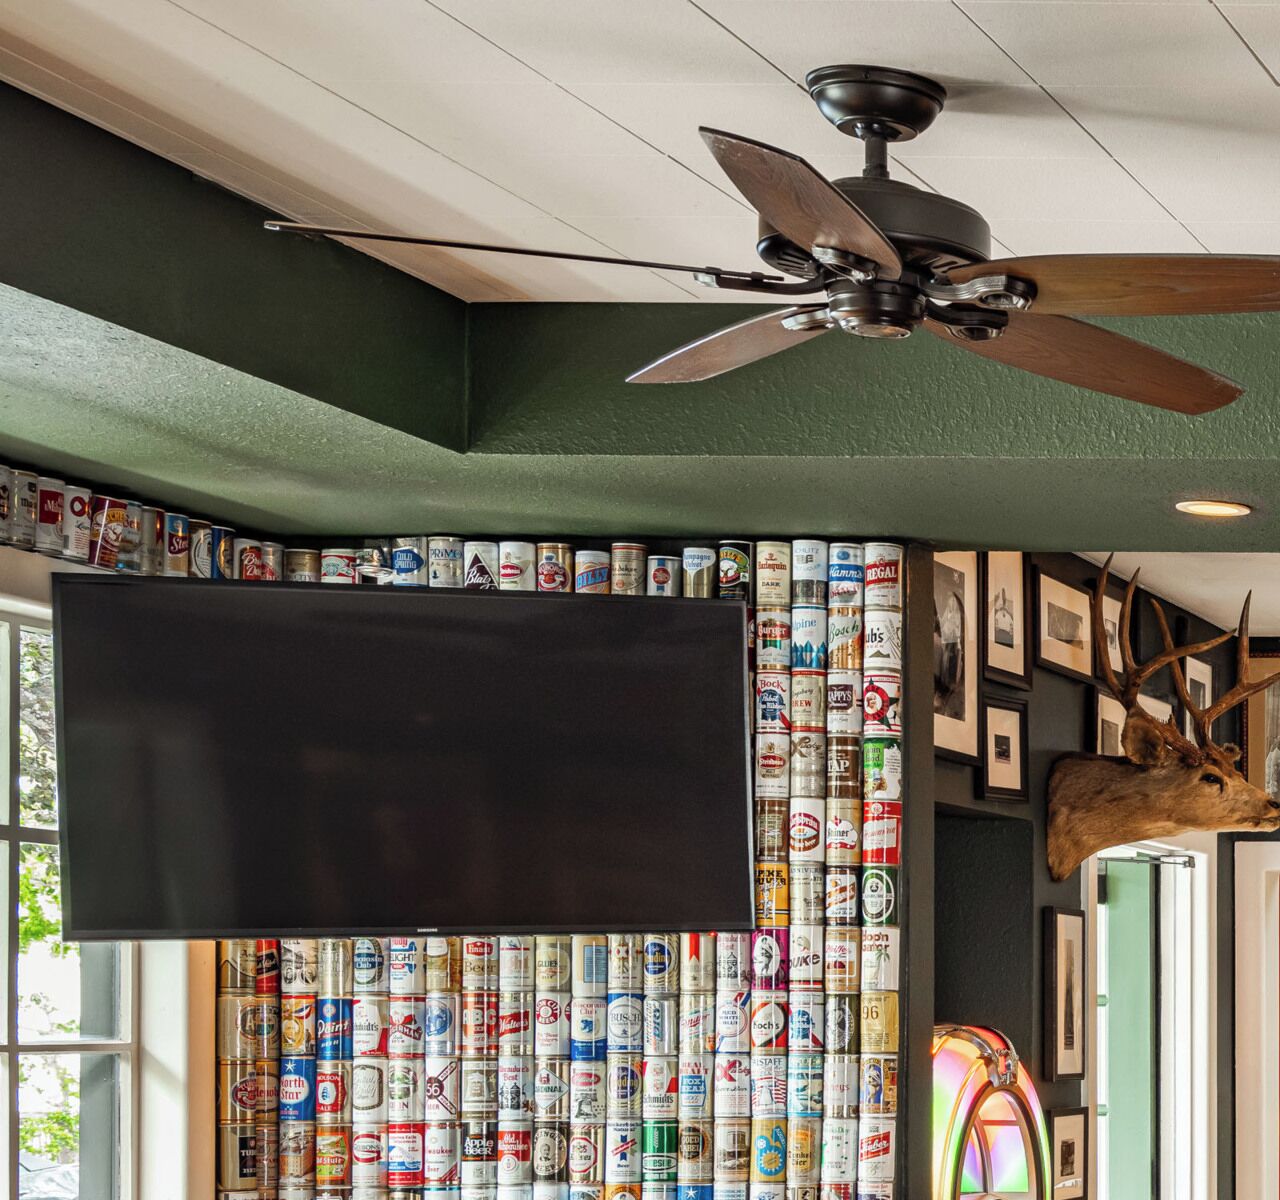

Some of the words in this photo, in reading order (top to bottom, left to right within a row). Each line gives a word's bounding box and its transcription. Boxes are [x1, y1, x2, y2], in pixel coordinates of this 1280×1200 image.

[867, 567, 897, 580] REGAL
[760, 680, 786, 692] Bock
[464, 960, 497, 973] Beer
[610, 1012, 641, 1023] BUSCH
[464, 1136, 494, 1150] Apple
